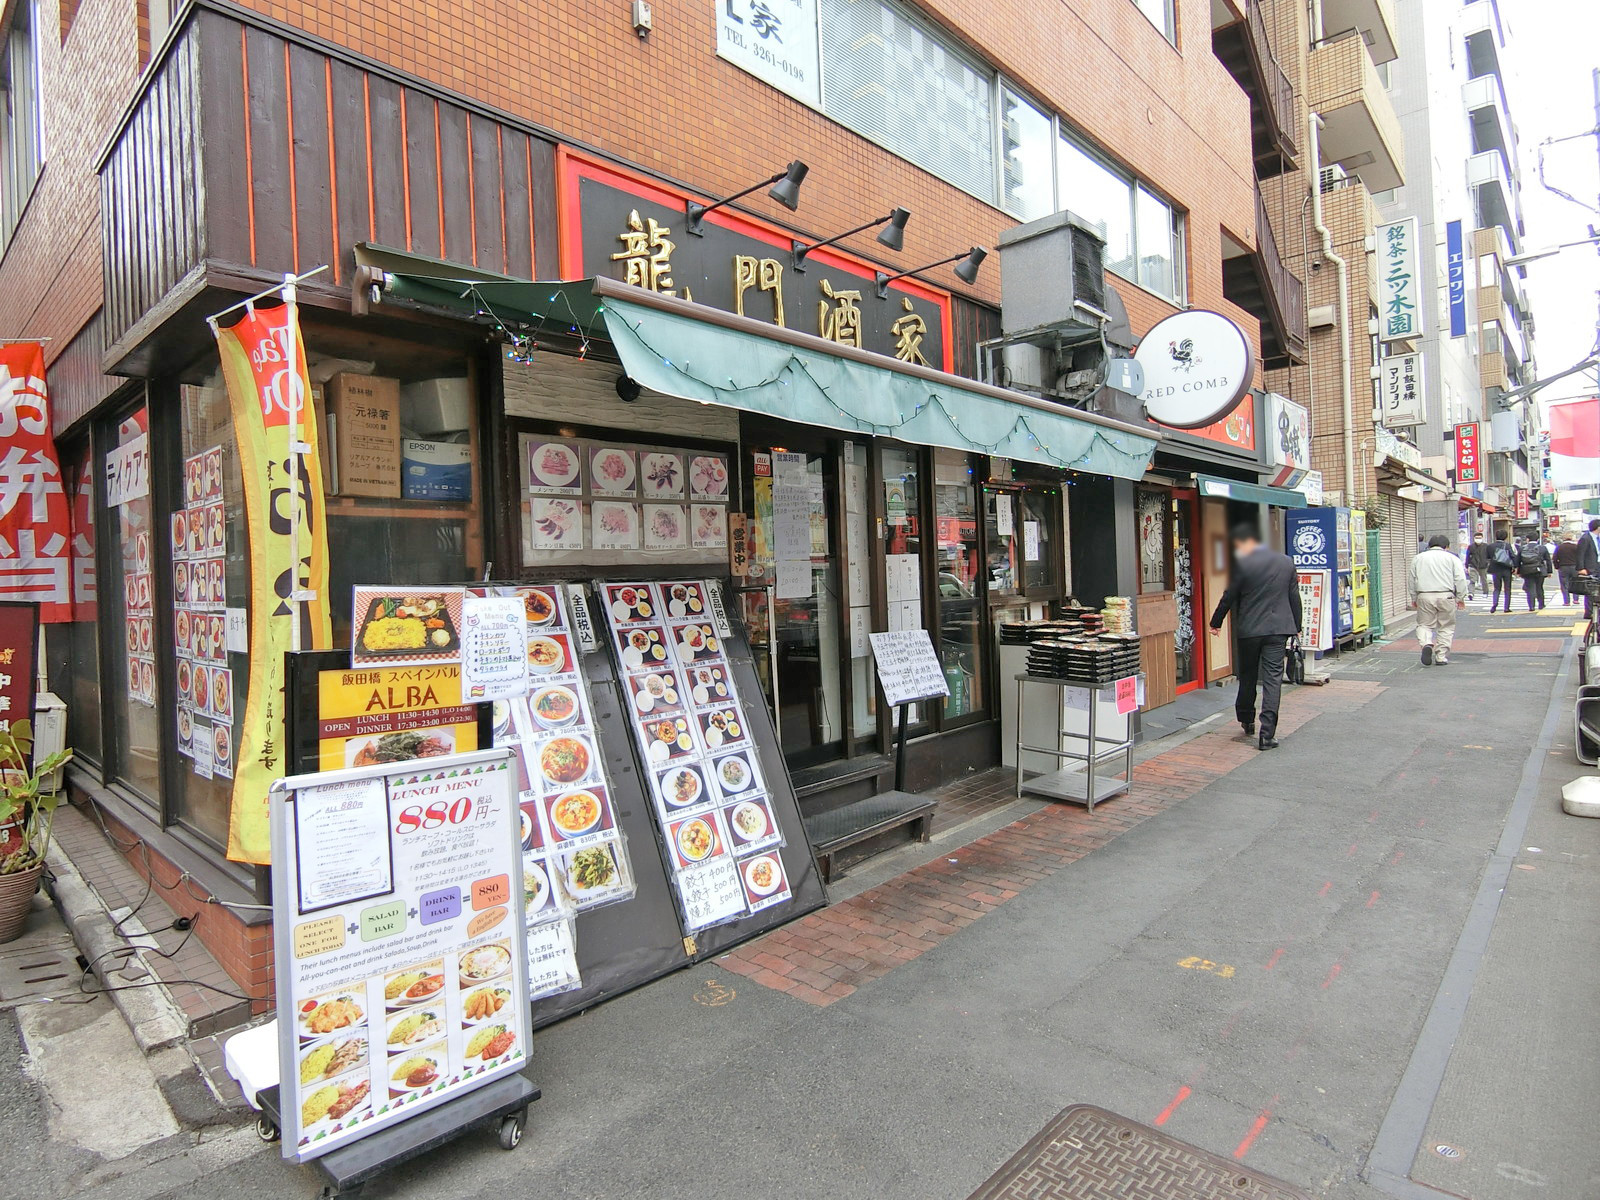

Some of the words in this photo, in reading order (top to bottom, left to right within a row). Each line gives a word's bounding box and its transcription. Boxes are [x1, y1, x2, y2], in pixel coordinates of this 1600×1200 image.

[724, 25, 748, 50] TEL
[753, 42, 805, 83] 3261-0198
[1386, 226, 1407, 258] 銘茶
[1448, 252, 1464, 305] エフワン
[1384, 259, 1415, 336] 三ツ木園
[1146, 385, 1175, 400] RED
[1182, 376, 1229, 393] COMB
[1389, 367, 1400, 410] マンション
[355, 405, 391, 421] 元禄箸
[409, 442, 436, 451] EPSON
[757, 464, 768, 472] PAY
[1296, 525, 1322, 535] COFFEE
[733, 527, 746, 566] 営業中
[1293, 553, 1328, 565] BOSS
[710, 587, 729, 631] 全品税込
[572, 594, 593, 644] 全品税込
[341, 672, 382, 686] 飯田橋
[388, 667, 460, 684] スペインバル
[365, 684, 440, 712] ALBA
[324, 722, 351, 732] OPEN
[356, 713, 390, 725] LUNCH
[356, 723, 393, 735] DINNER
[316, 781, 345, 793] Lunch
[347, 779, 372, 790] menu
[391, 785, 440, 801] LUNCH
[444, 778, 483, 792] MENU
[523, 790, 536, 798] 税込
[477, 795, 493, 805] 税込
[395, 796, 472, 835] 880
[580, 834, 598, 844] 830円
[602, 829, 614, 838] 税込
[684, 871, 706, 890] 餃子
[708, 860, 735, 880] 400円
[478, 883, 499, 896] 880
[713, 874, 737, 893] 500円
[425, 893, 456, 908] DRINK
[719, 888, 742, 905] 500円
[367, 909, 400, 922] SALAD
[430, 907, 450, 917] BAR
[303, 919, 334, 931] PLEASE
[374, 922, 394, 934] BAR
[303, 928, 334, 939] SELECT
[297, 948, 320, 958] LUNCH
[321, 941, 344, 953] TODAY
[299, 939, 317, 949] ONE
[321, 935, 338, 944] FOR
[300, 961, 318, 971] Their
[318, 956, 338, 968] lunch
[339, 952, 362, 963] menus
[362, 945, 384, 957] include
[384, 939, 404, 951] salad
[404, 934, 415, 944] bar
[415, 930, 428, 942] and
[428, 926, 443, 938] drink
[443, 924, 454, 933] bar
[299, 961, 352, 983] All-you-can-eat
[353, 956, 366, 968] and
[366, 951, 383, 965] drink
